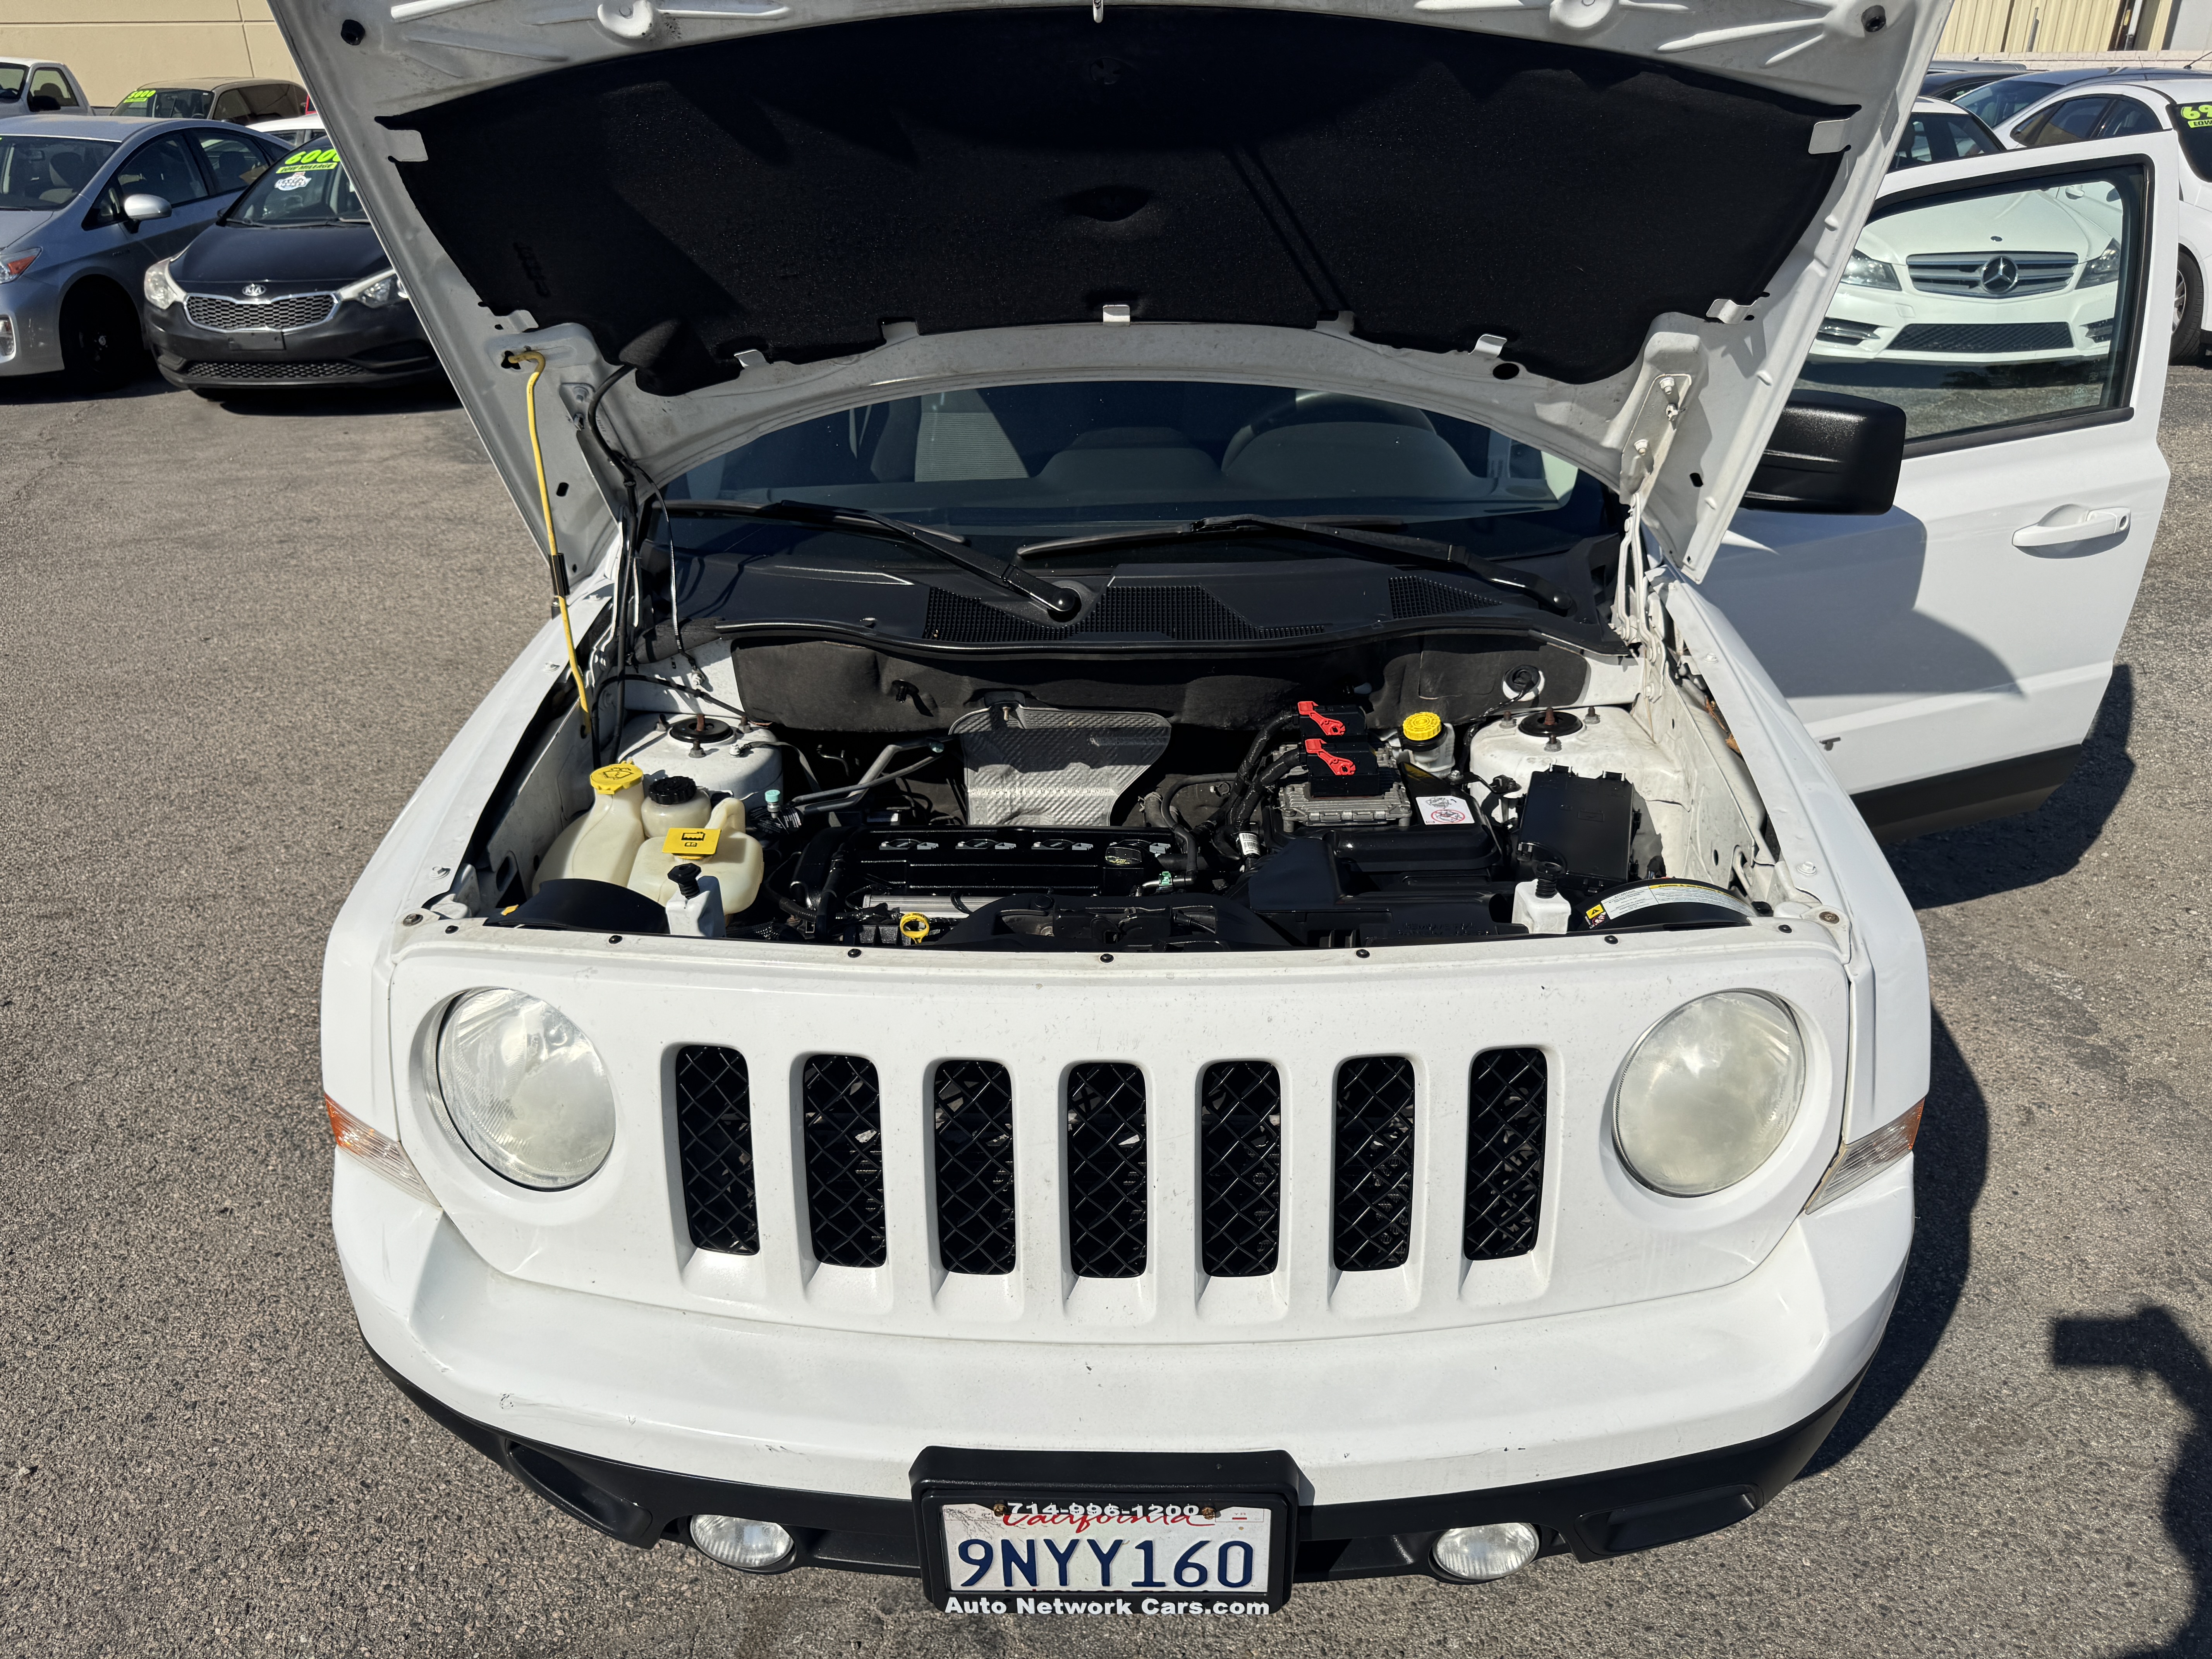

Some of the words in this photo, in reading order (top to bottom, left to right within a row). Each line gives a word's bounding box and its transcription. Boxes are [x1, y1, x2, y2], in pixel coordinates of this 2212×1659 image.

[1008, 1503, 1199, 1516] 714-996-1200
[958, 1538, 1254, 1588] 9NYY160
[945, 1597, 1007, 1614] Auto
[1017, 1598, 1134, 1615] Network
[1141, 1598, 1269, 1615] Cars.com
